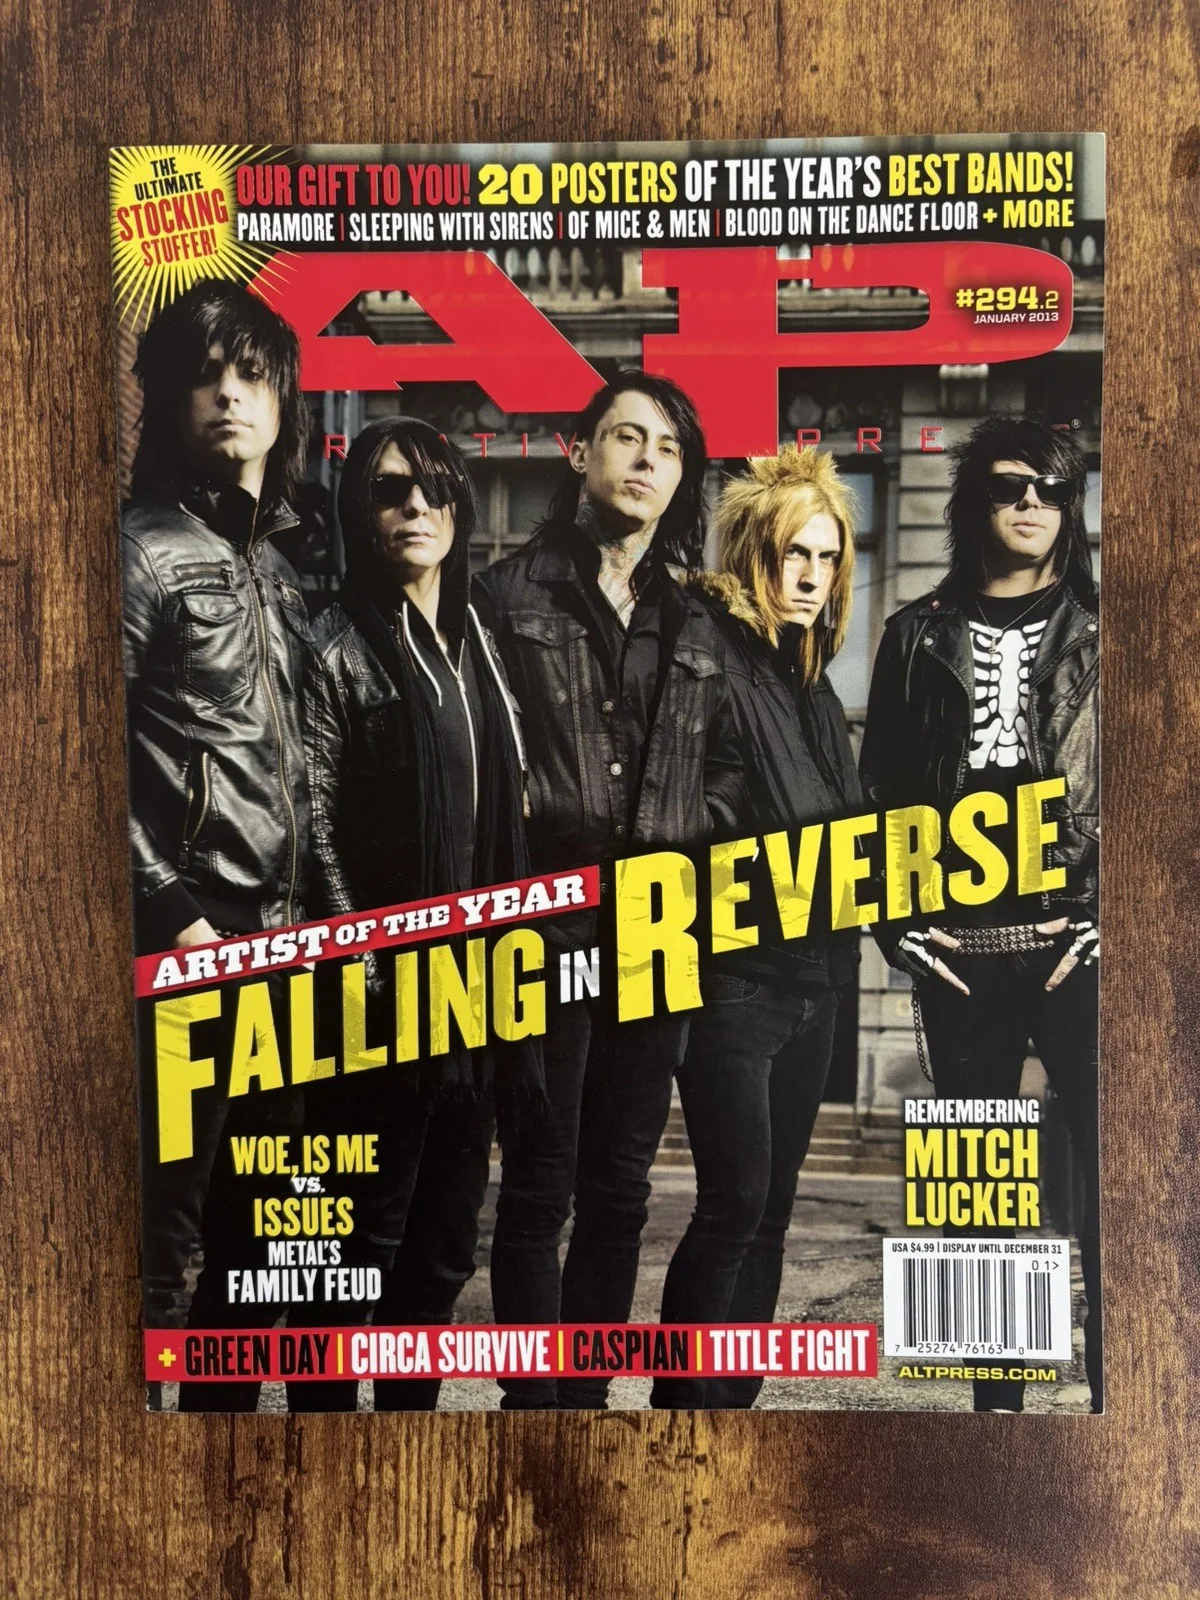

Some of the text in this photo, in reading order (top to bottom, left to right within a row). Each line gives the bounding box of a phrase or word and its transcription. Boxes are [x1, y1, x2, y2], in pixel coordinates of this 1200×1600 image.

[134, 171, 204, 201] ULTIMATE
[150, 157, 178, 178] THE
[236, 151, 1073, 206] OUR GIFT TO YOU! 20 POSTERS OF THE YEAR'S BEST BANDS!
[117, 188, 229, 241] STOCKING
[237, 212, 335, 242] PARAMORE
[349, 212, 434, 242] SLEEPING
[438, 211, 484, 241] WITH
[489, 211, 553, 241] SIRENS
[568, 211, 589, 240] OF
[595, 210, 641, 239] MICE
[646, 210, 664, 239] &
[669, 209, 710, 238] MEN
[725, 207, 782, 237] BLOOD
[788, 206, 812, 236] ON
[817, 205, 850, 235] THE
[856, 203, 914, 234] DANCE
[920, 201, 978, 232] FLOOR
[1003, 199, 1074, 229] MORE
[141, 228, 219, 267] STUFFER!
[956, 286, 1059, 312] #294.2
[974, 312, 1059, 324] JANUARY 2013
[152, 874, 586, 990] ARTIST OF THE YEAR
[155, 777, 1068, 1164] FALLING IN REVERSE
[904, 1099, 1039, 1123] REMEMBERING
[231, 1134, 379, 1178] WOE, IS ME
[905, 1129, 1039, 1178] MITCH
[254, 1197, 354, 1237] ISSUES
[906, 1182, 1040, 1226] LUCKER
[268, 1240, 341, 1266] METAL'S
[892, 1242, 1062, 1255] USA $4.99 DISPLAY UNTIL DECEMBER 31
[228, 1267, 382, 1303] FAMILY FEUD
[185, 1335, 270, 1376] GREEN
[279, 1333, 330, 1375] DAY
[351, 1331, 432, 1374] CIRCA
[438, 1328, 550, 1373] SURVIVE
[572, 1328, 689, 1371] CASPIAN
[709, 1329, 783, 1371] TITLE
[791, 1327, 870, 1372] FIGHT
[895, 1343, 1025, 1355] 7 25274 76163 0
[899, 1366, 1057, 1381] ALTPRESS.COM
